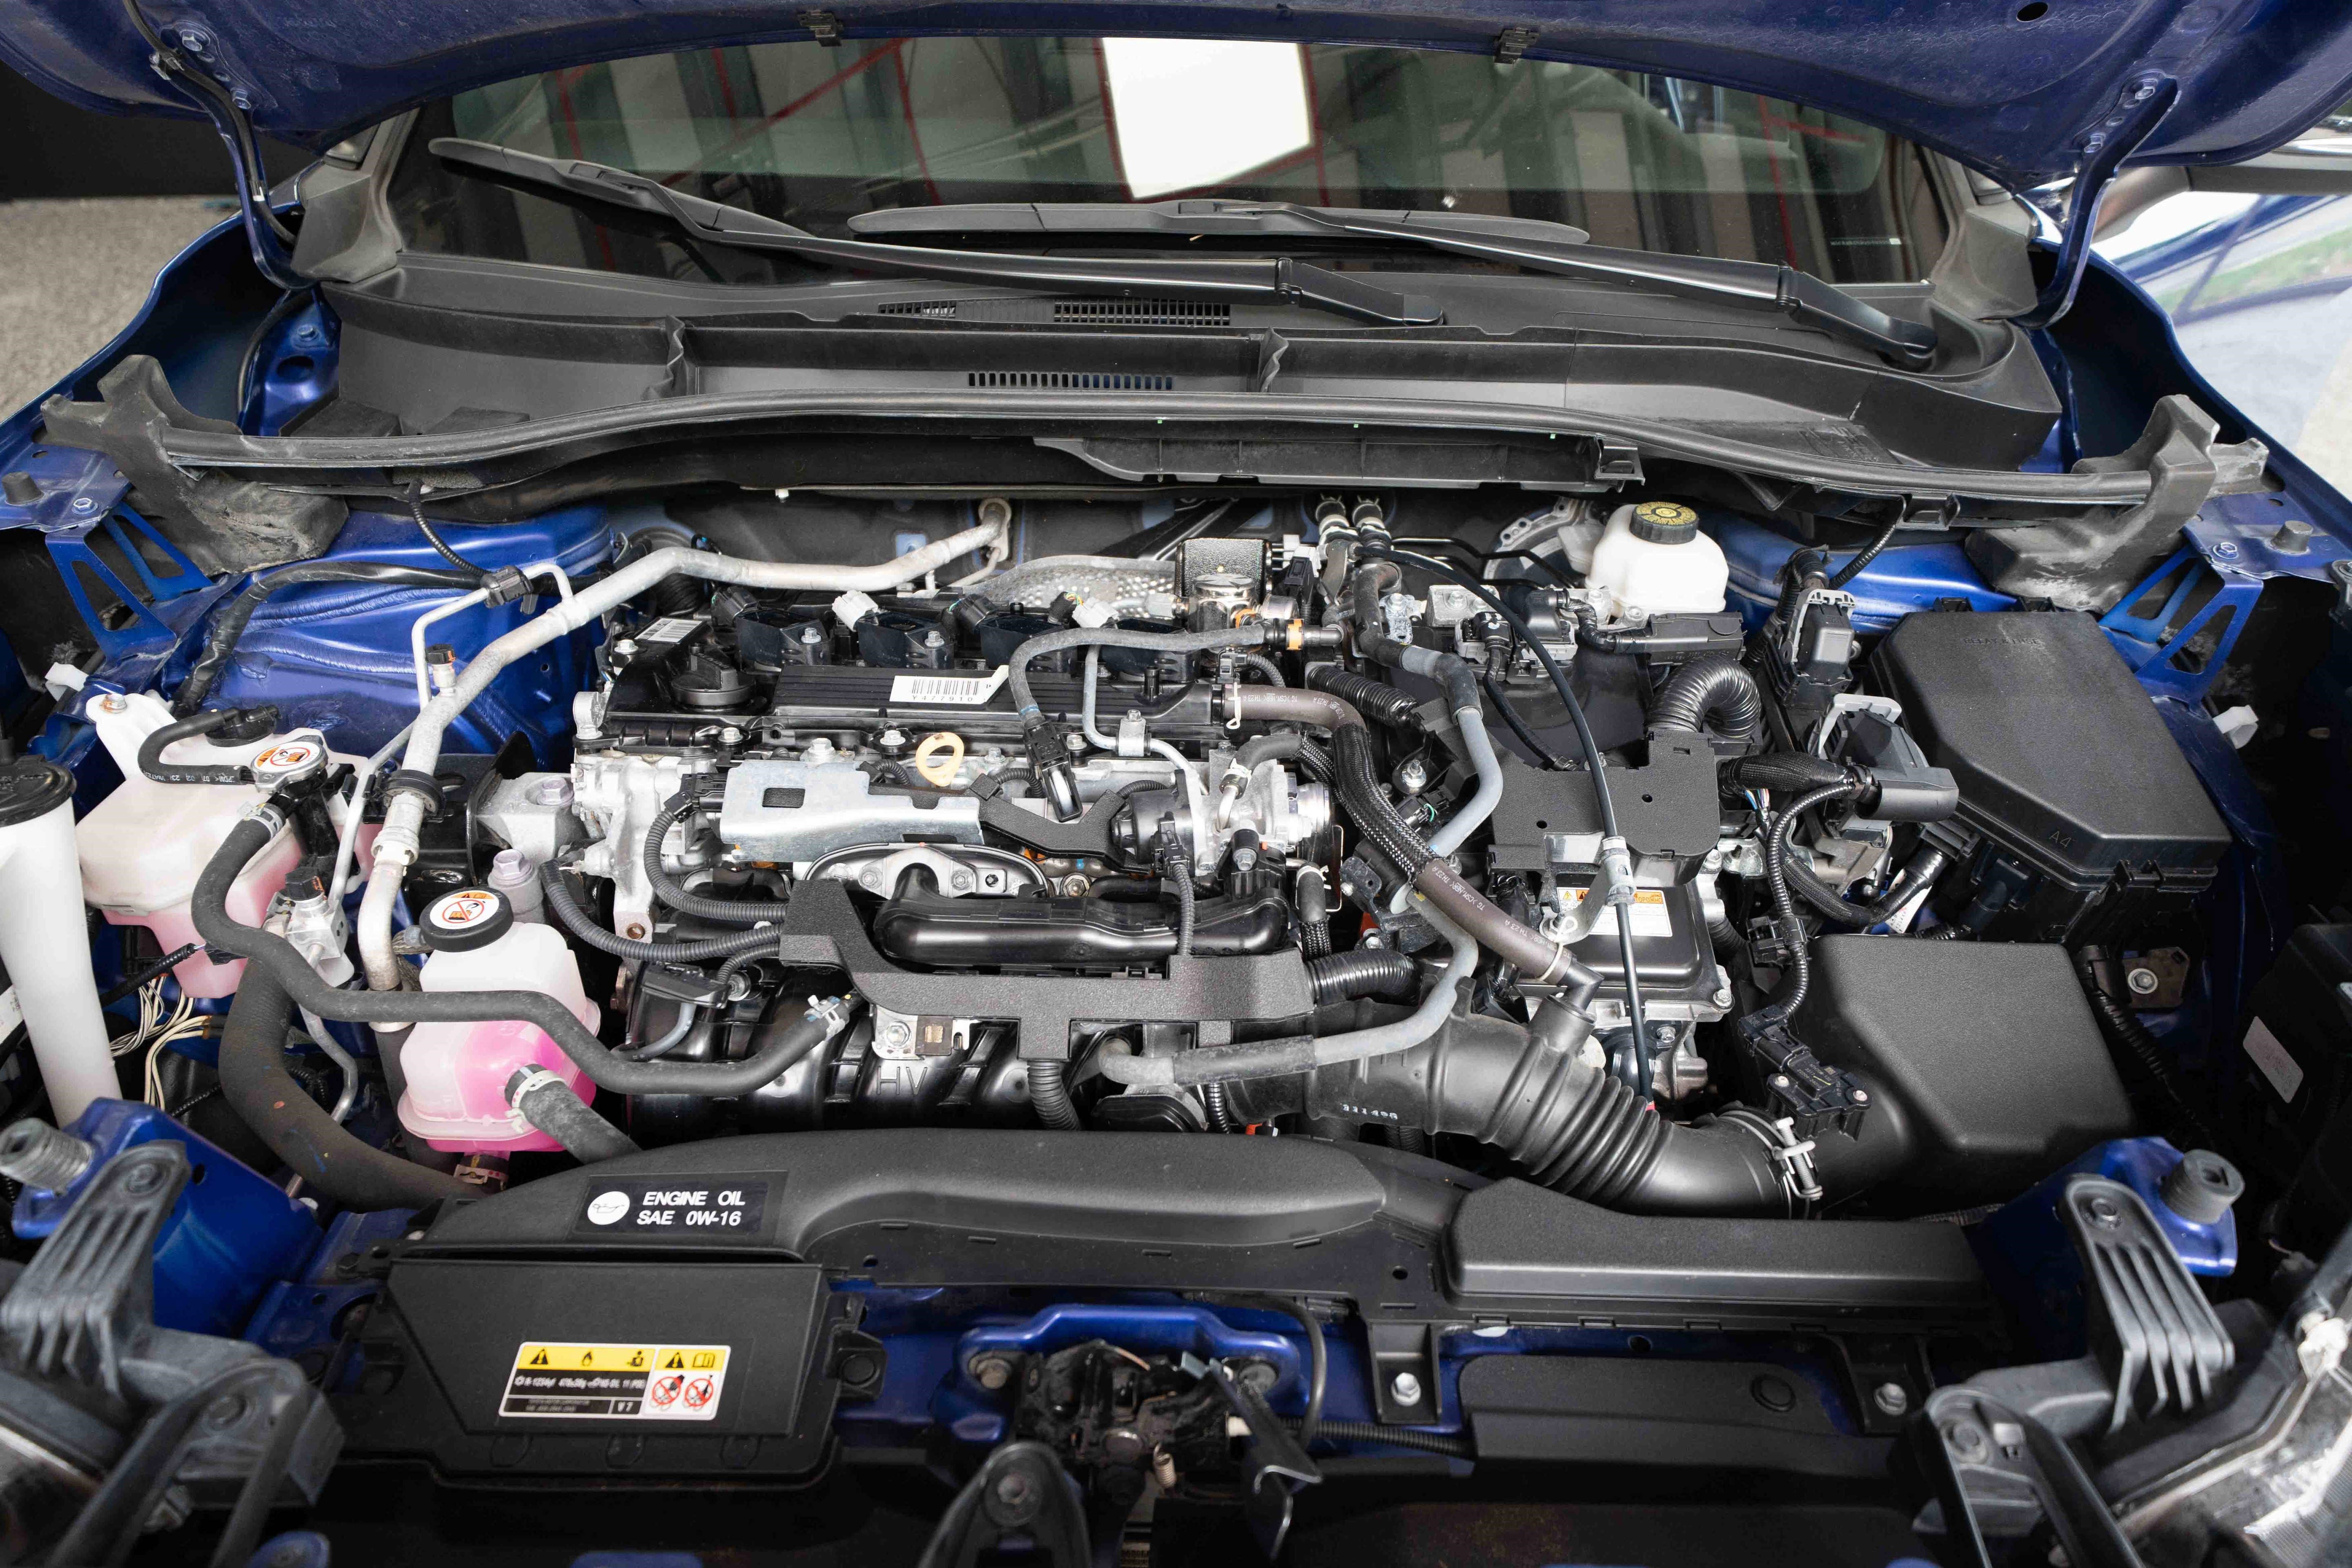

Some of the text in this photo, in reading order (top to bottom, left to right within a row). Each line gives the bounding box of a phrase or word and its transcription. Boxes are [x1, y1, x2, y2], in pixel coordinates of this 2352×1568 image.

[876, 1065, 927, 1096] HV
[643, 1190, 746, 1205] ENGINE OIL
[637, 1210, 742, 1226] SAE 0W-16
